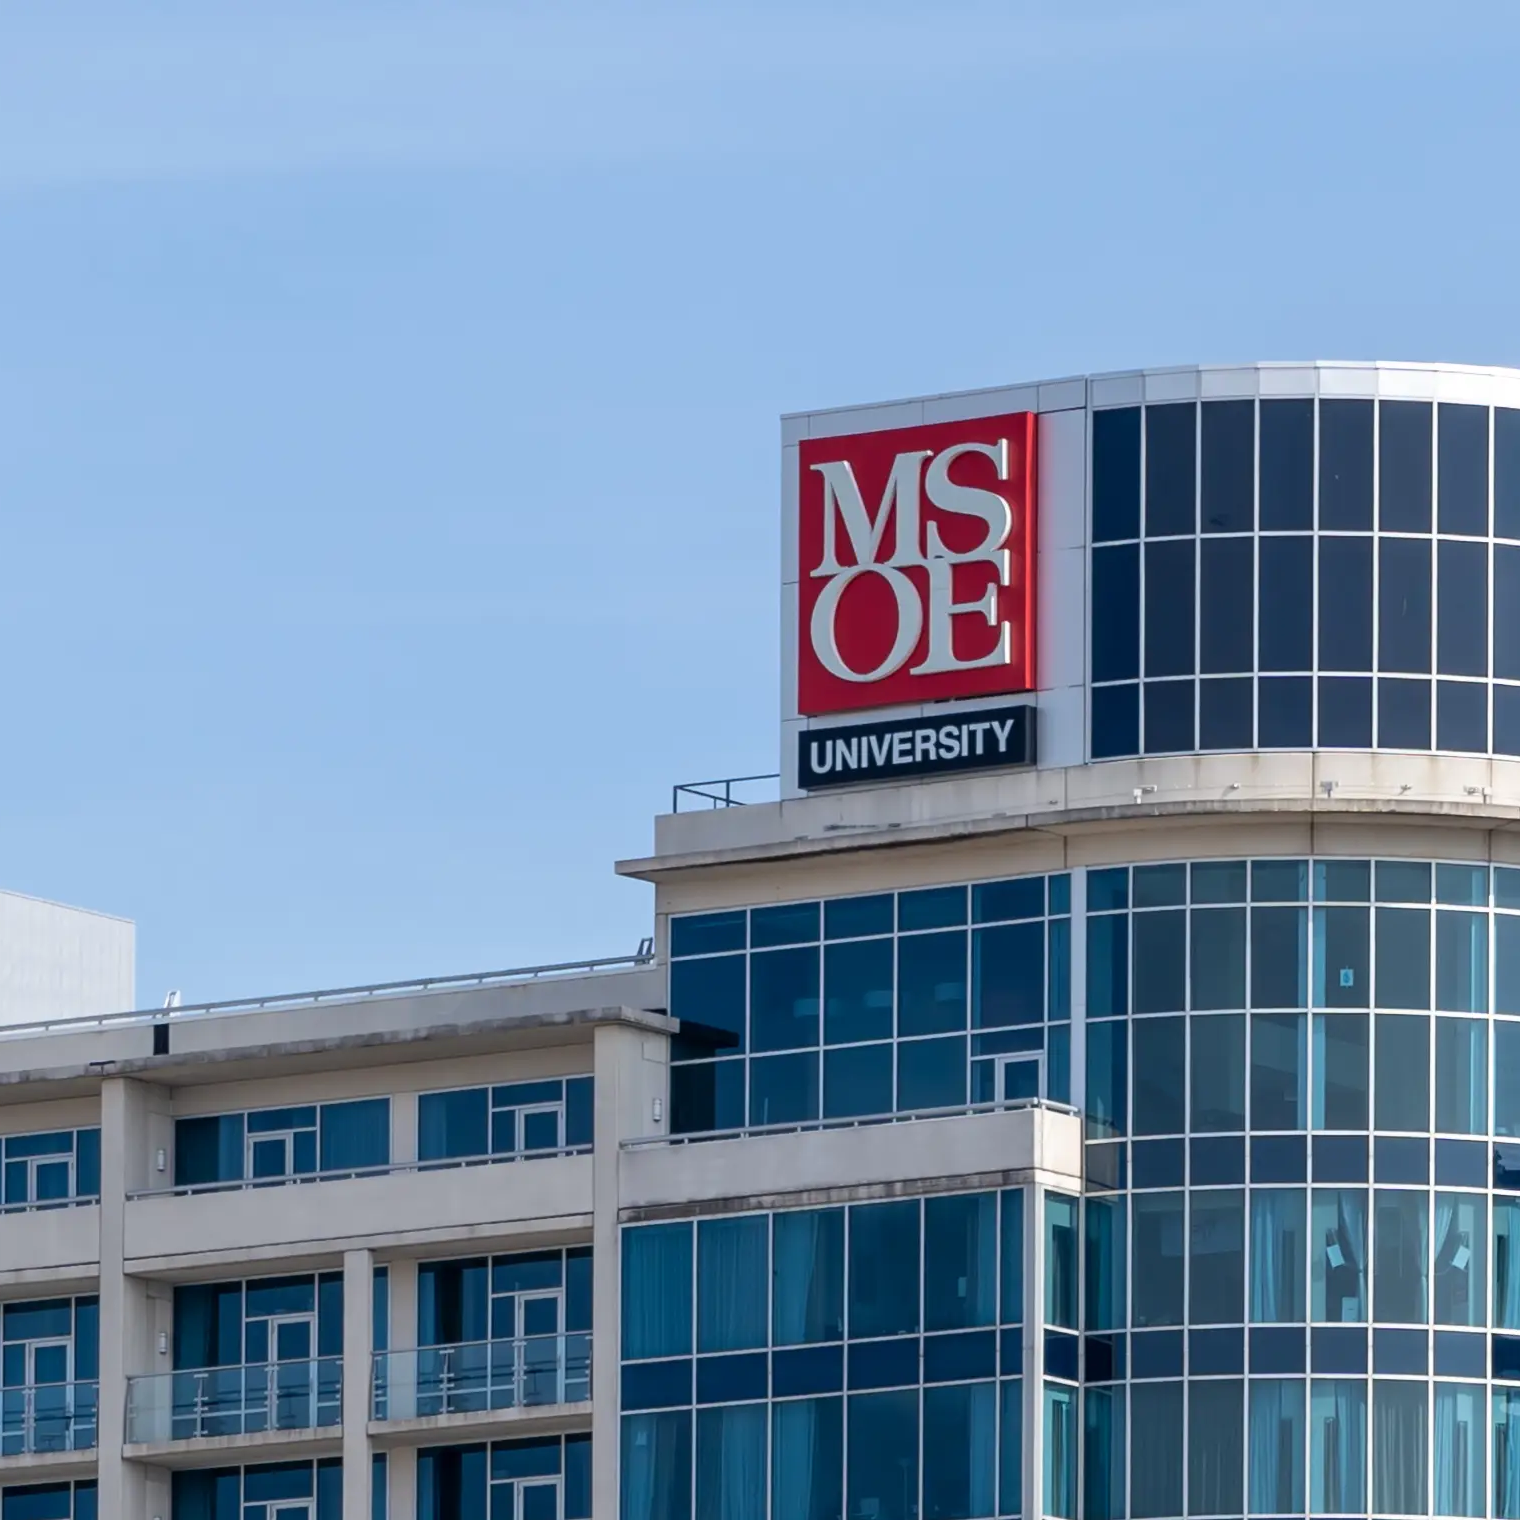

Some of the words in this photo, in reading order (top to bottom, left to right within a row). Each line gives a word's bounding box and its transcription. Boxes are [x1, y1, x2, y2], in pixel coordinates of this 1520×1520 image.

[809, 438, 1013, 578] MS
[810, 548, 1011, 683] OE
[810, 719, 1015, 774] UNIVERSITY
